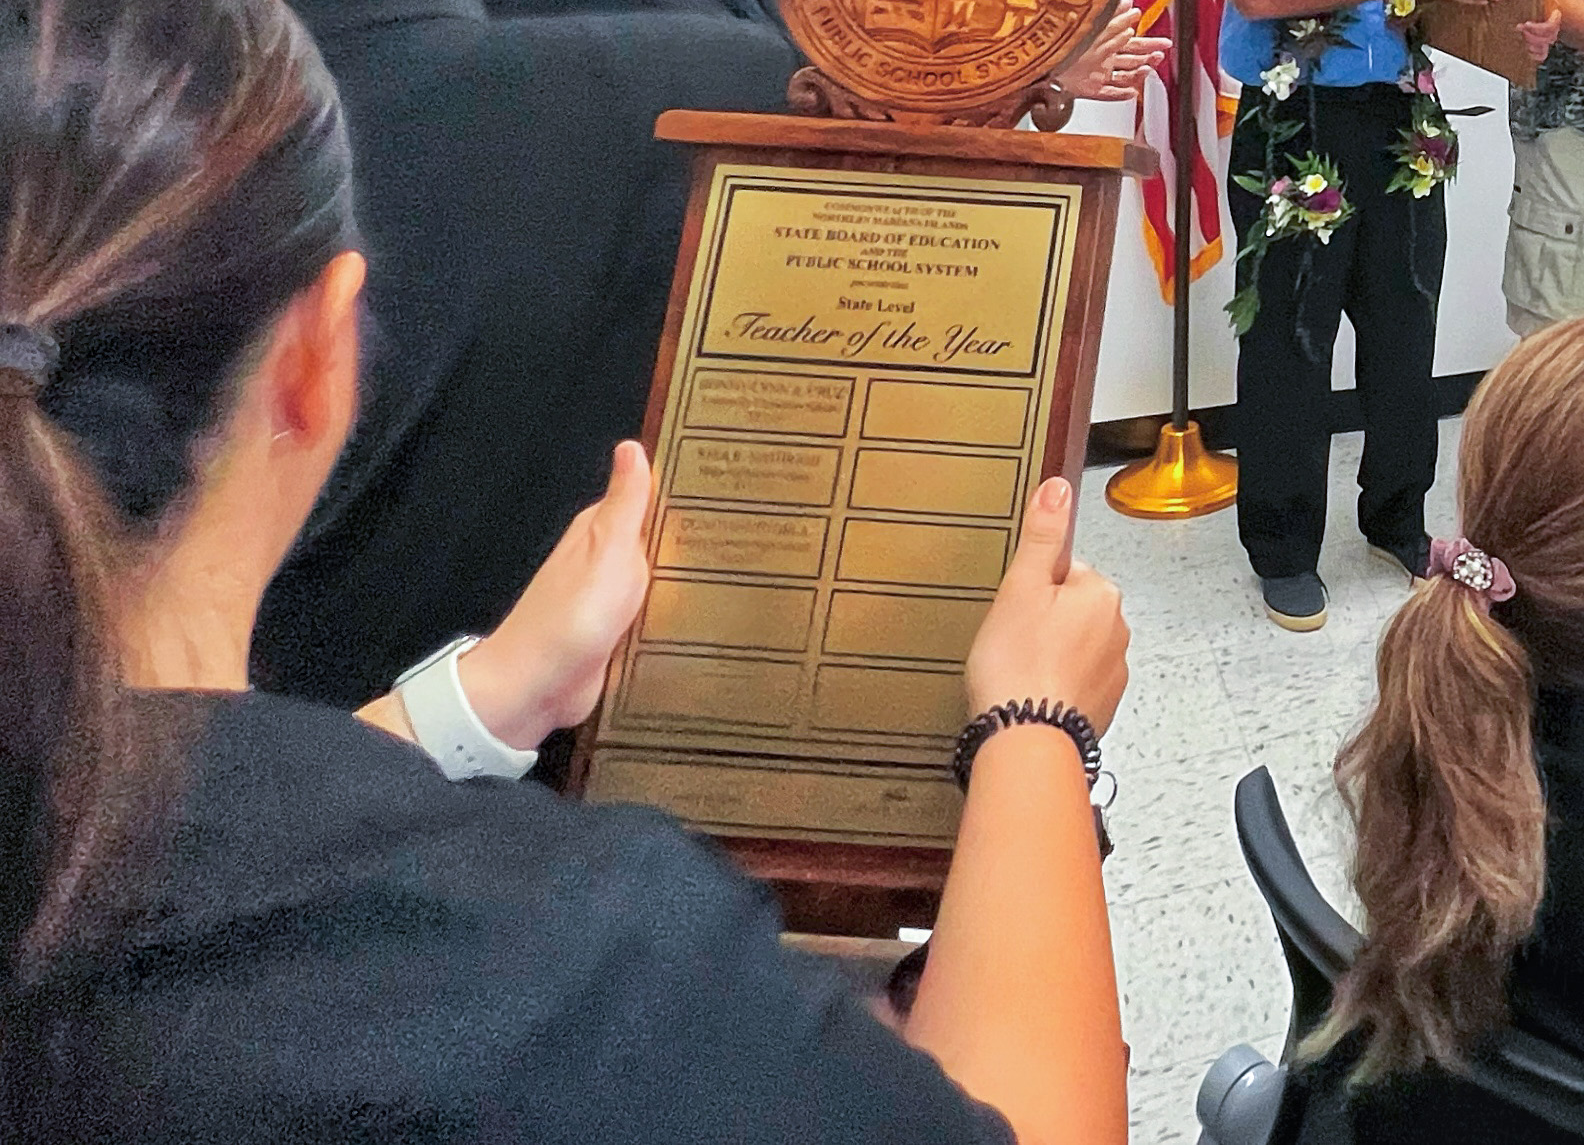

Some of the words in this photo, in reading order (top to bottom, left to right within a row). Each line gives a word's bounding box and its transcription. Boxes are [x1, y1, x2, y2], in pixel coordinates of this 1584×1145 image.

[811, 6, 874, 67] PUBLIC
[876, 61, 969, 87] SCHOOL
[976, 17, 1059, 79] SYSTEM
[775, 226, 821, 240] STATE
[825, 229, 881, 244] BOARD
[884, 233, 906, 245] OF
[909, 234, 1001, 251] EDUCATION
[786, 255, 845, 270] PUBLIC
[847, 258, 911, 274] SCHOOL
[916, 262, 979, 278] SYSTEM
[836, 295, 873, 310] State
[877, 299, 915, 314] Level
[724, 312, 842, 344] Teacher
[841, 320, 891, 359] of
[882, 321, 931, 351] the
[932, 323, 1013, 363] Year
